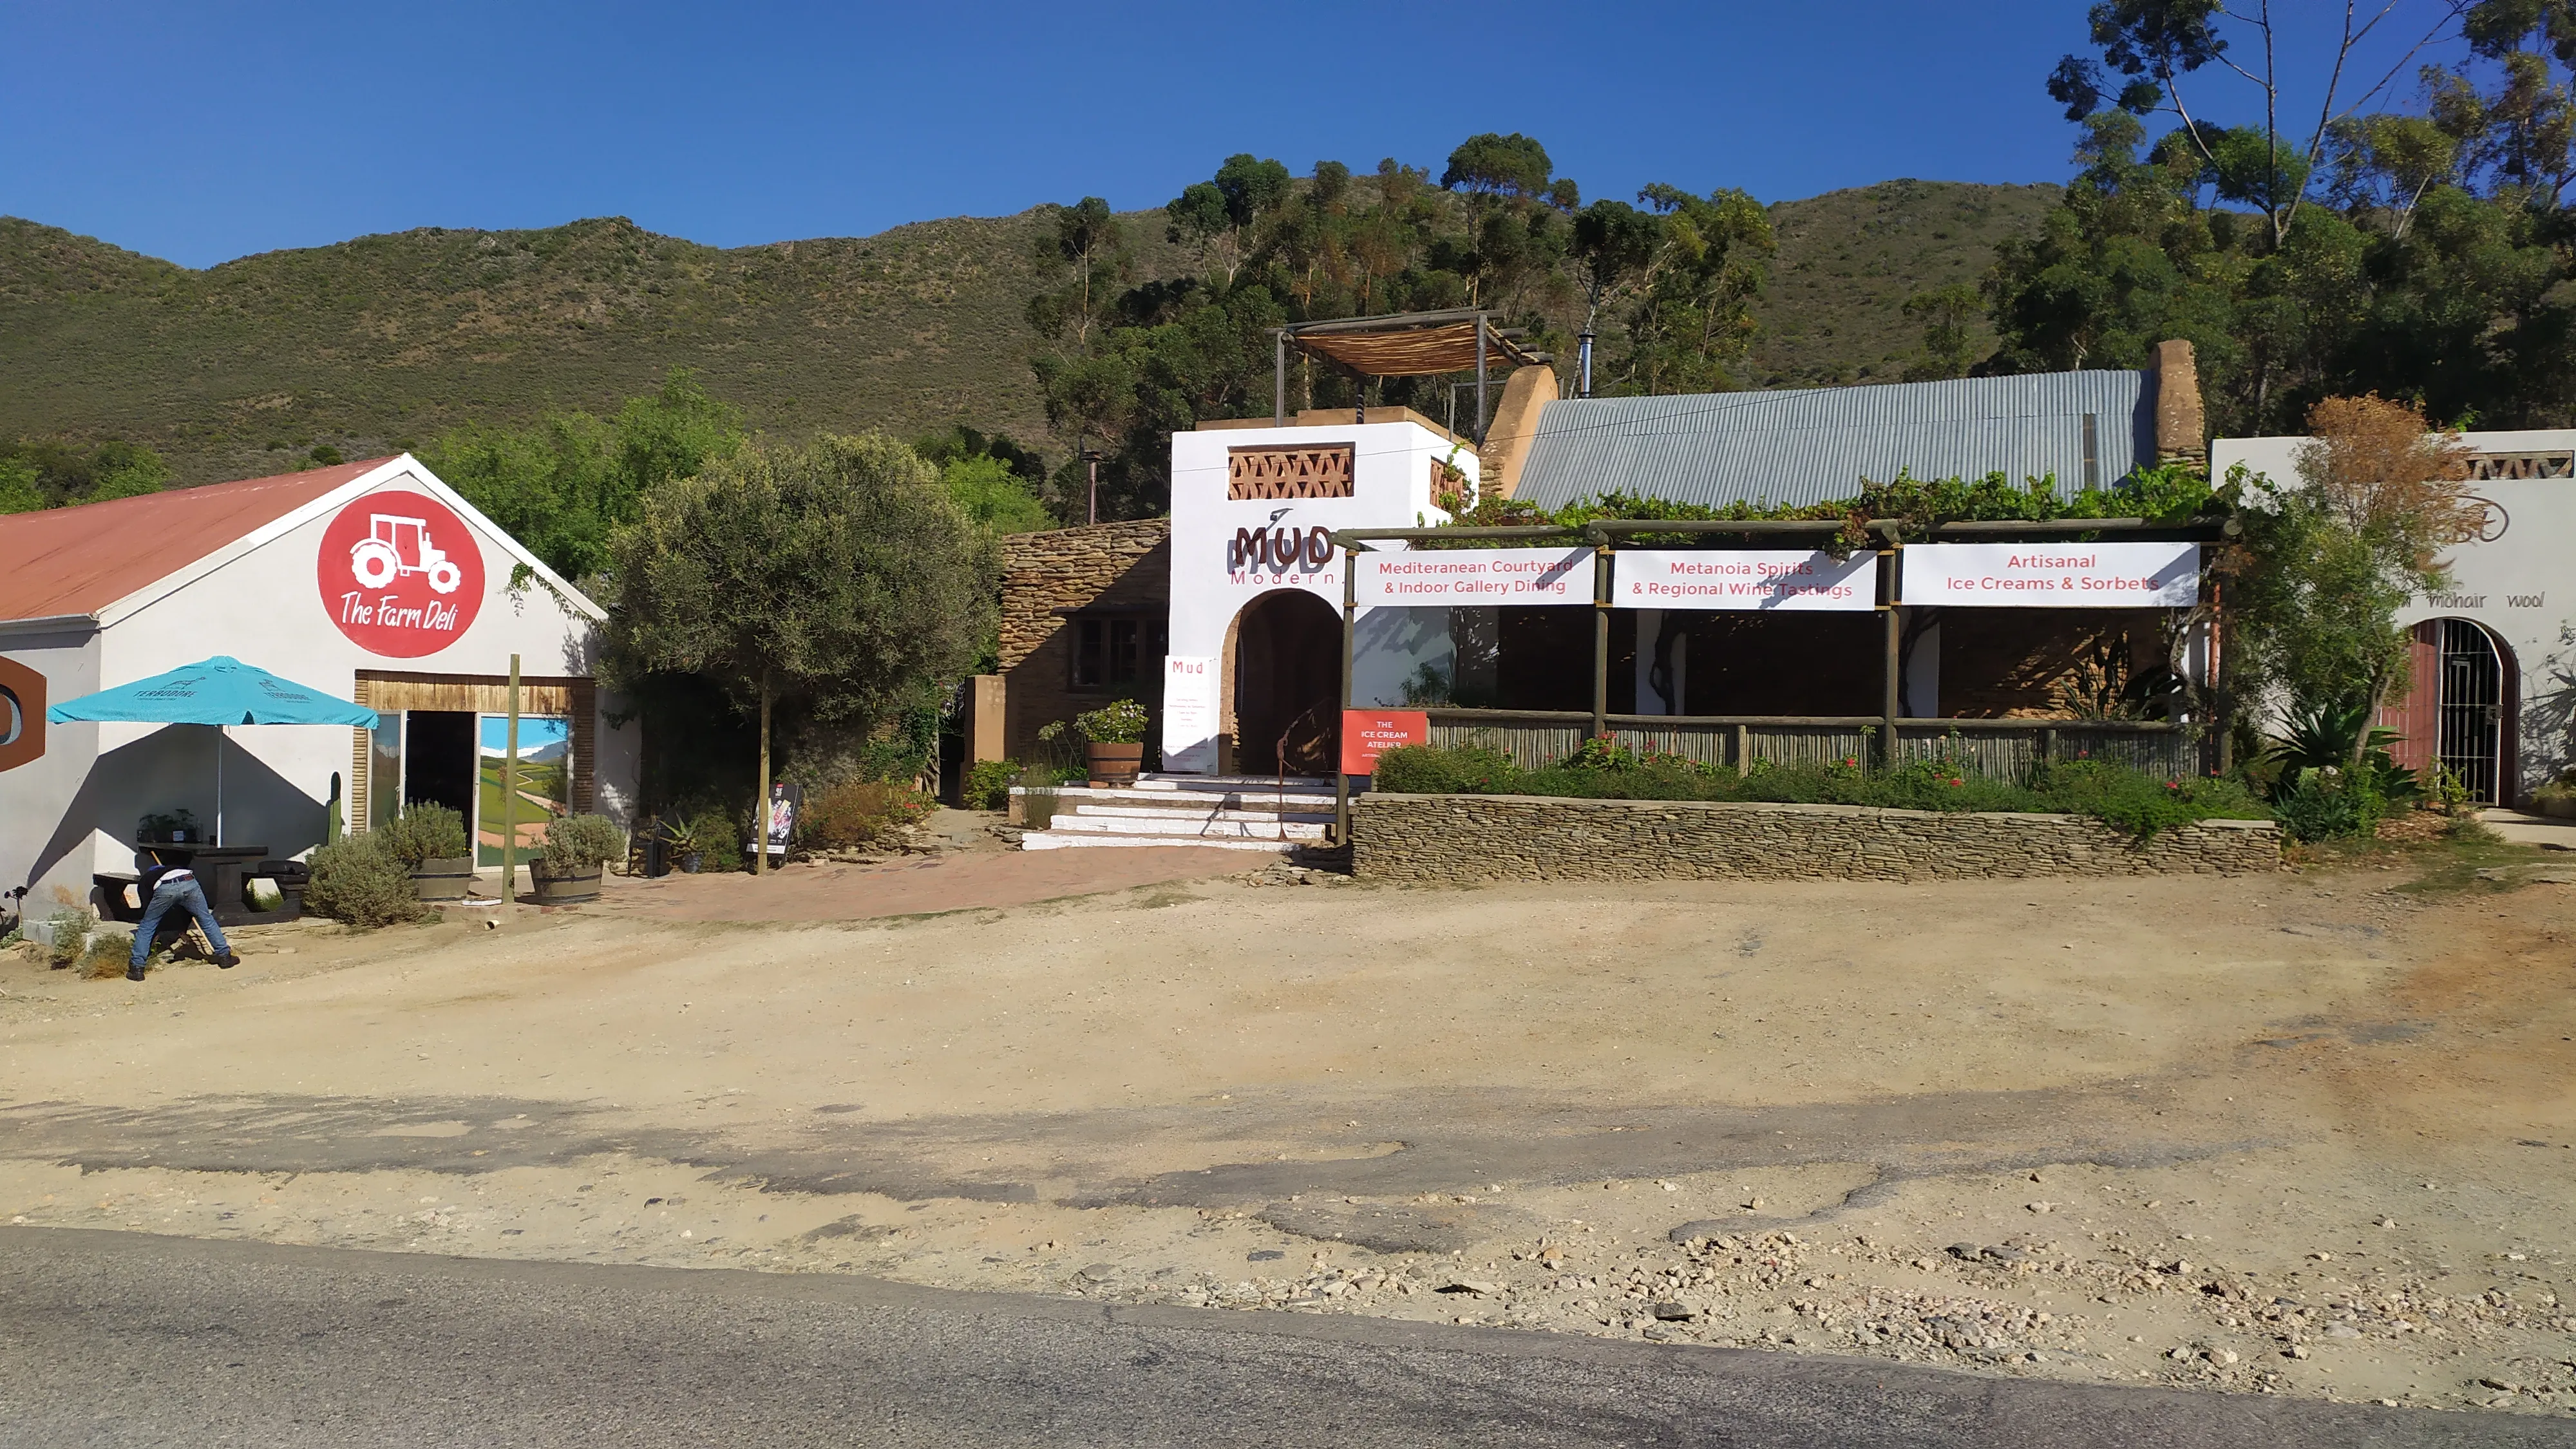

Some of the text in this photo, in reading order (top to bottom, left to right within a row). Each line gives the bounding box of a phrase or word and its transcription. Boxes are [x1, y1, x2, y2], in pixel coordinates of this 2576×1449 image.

[1235, 526, 1334, 565] MUD
[1379, 558, 1573, 575] Mediteranean Courtyard
[1670, 562, 1814, 577] Metanoia Spirits
[2007, 554, 2096, 569] Artisanal
[1385, 579, 1566, 596] & Indoor Gallery Dining
[1632, 582, 1853, 600] & Regional Wine Tastings
[1947, 576, 2159, 591] Ice Creams & Sorbets
[2506, 591, 2546, 608] wool
[340, 591, 459, 631] The Farm Deli
[1173, 661, 1203, 674] Mud
